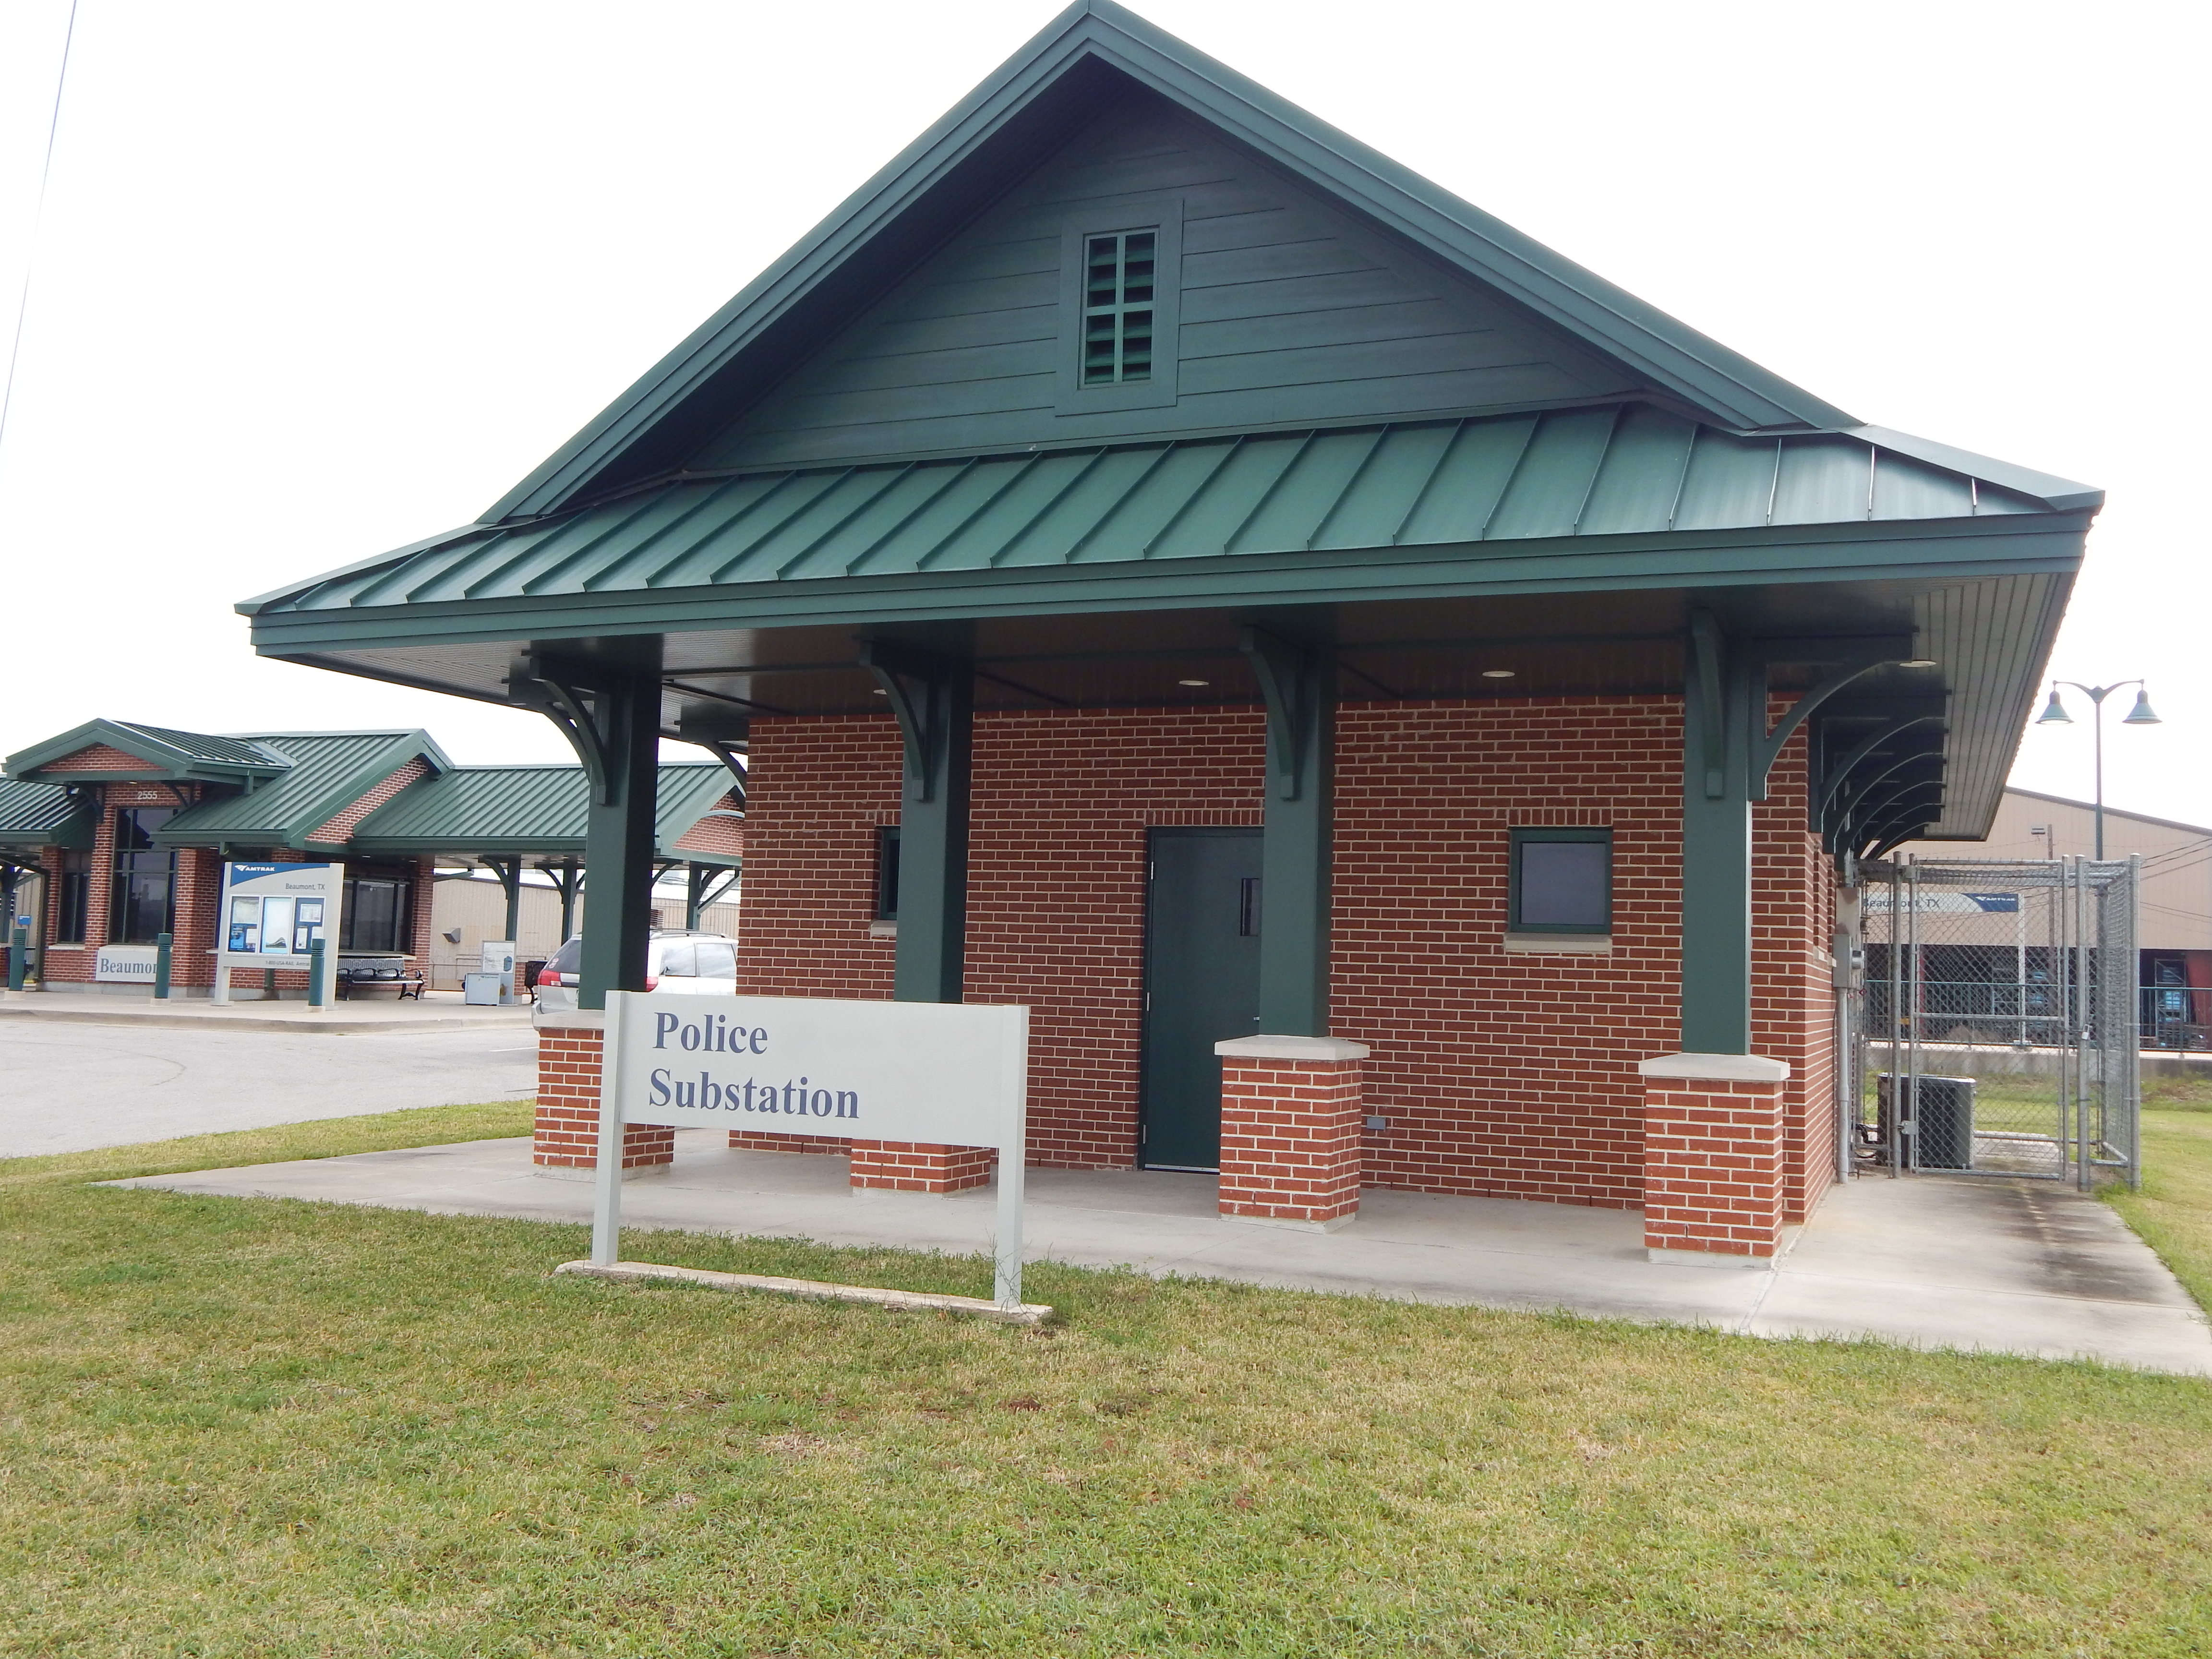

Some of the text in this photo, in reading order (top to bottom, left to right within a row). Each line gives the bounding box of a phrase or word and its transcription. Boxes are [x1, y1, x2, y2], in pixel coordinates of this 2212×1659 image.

[137, 791, 158, 800] 2555
[1925, 899, 1940, 908] TX
[652, 1012, 768, 1055] Police
[649, 1068, 860, 1118] Substation
